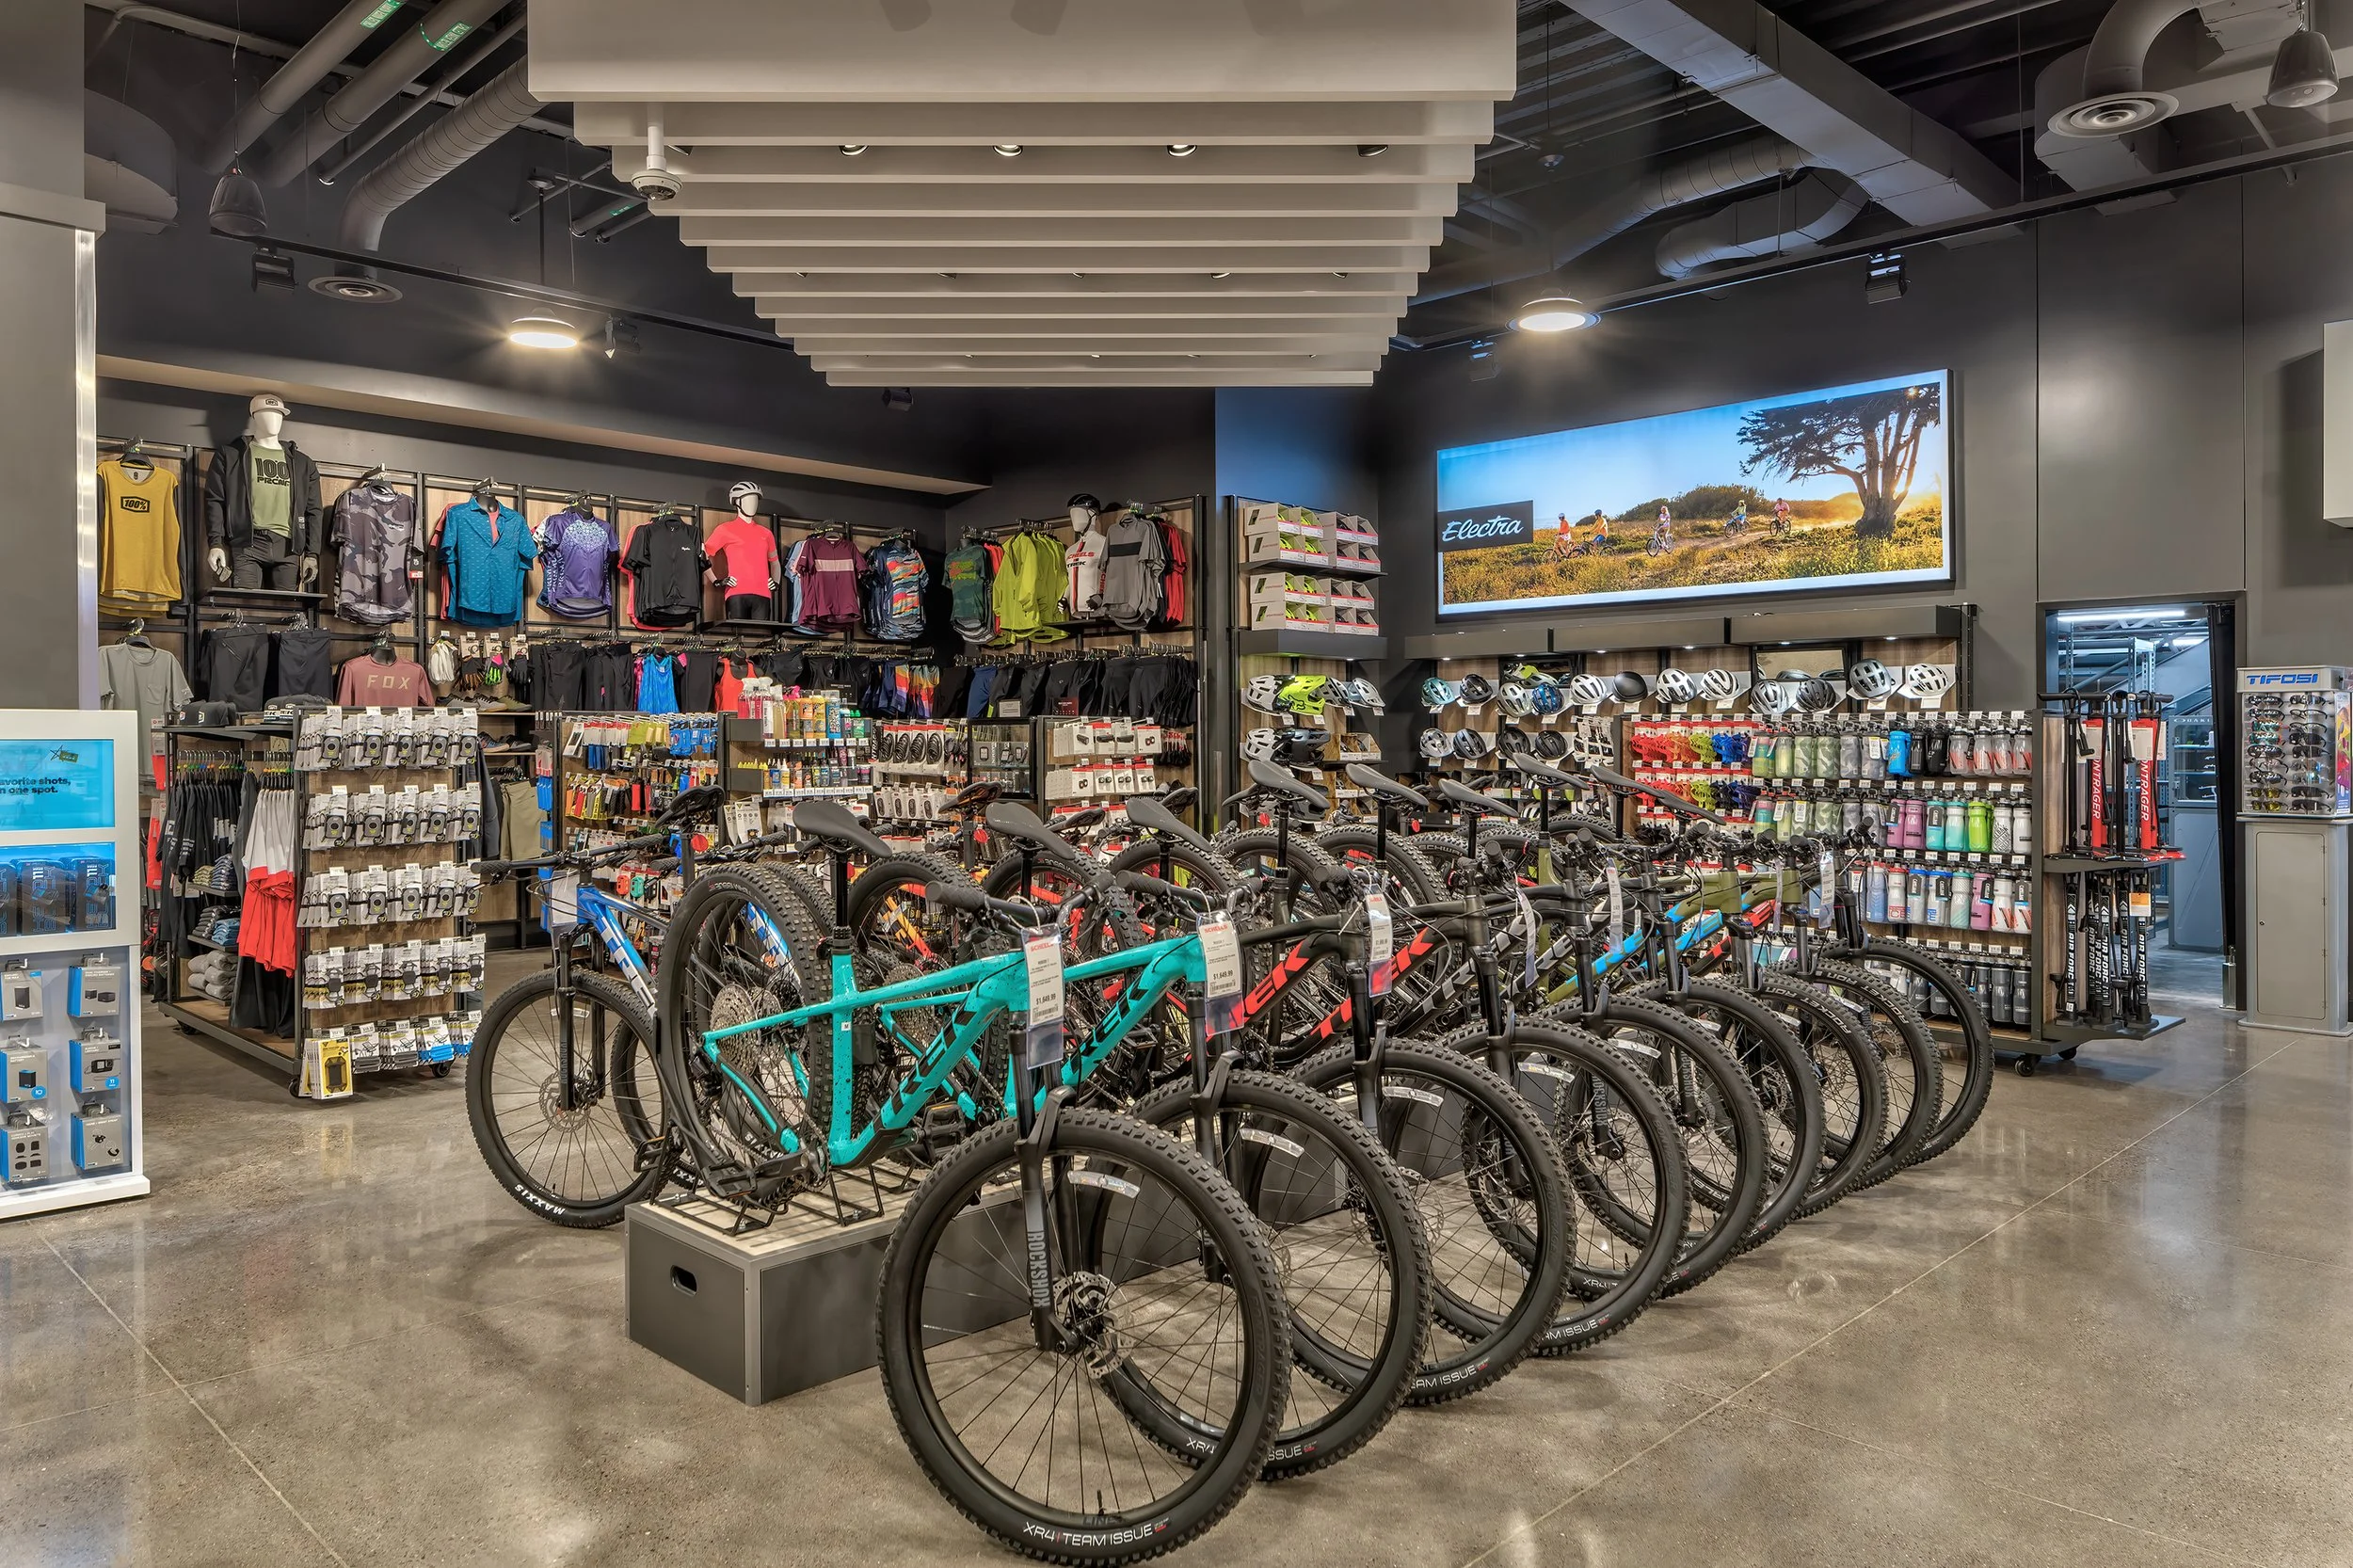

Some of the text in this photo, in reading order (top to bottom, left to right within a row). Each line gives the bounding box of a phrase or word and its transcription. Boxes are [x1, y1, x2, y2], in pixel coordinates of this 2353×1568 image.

[123, 498, 148, 510] 100%
[1442, 515, 1524, 542] Electra
[366, 674, 411, 690] FOX
[2246, 673, 2319, 685] TIFOSI
[31, 785, 58, 794] spot.
[39, 776, 72, 786] shots,
[1827, 971, 1910, 1024] RON ROCKET
[1766, 986, 1852, 1034] RON ROCKET
[514, 1183, 566, 1216] MAXXIS
[1027, 1230, 1050, 1308] ROCKSHOX
[1562, 1320, 1598, 1337] ISSUE
[1440, 1365, 1477, 1385] ISSUE
[1268, 1444, 1303, 1461] SSUE
[1023, 1521, 1056, 1543] XR4
[1063, 1532, 1107, 1547] TEAM
[1110, 1523, 1154, 1545] ISSUE
